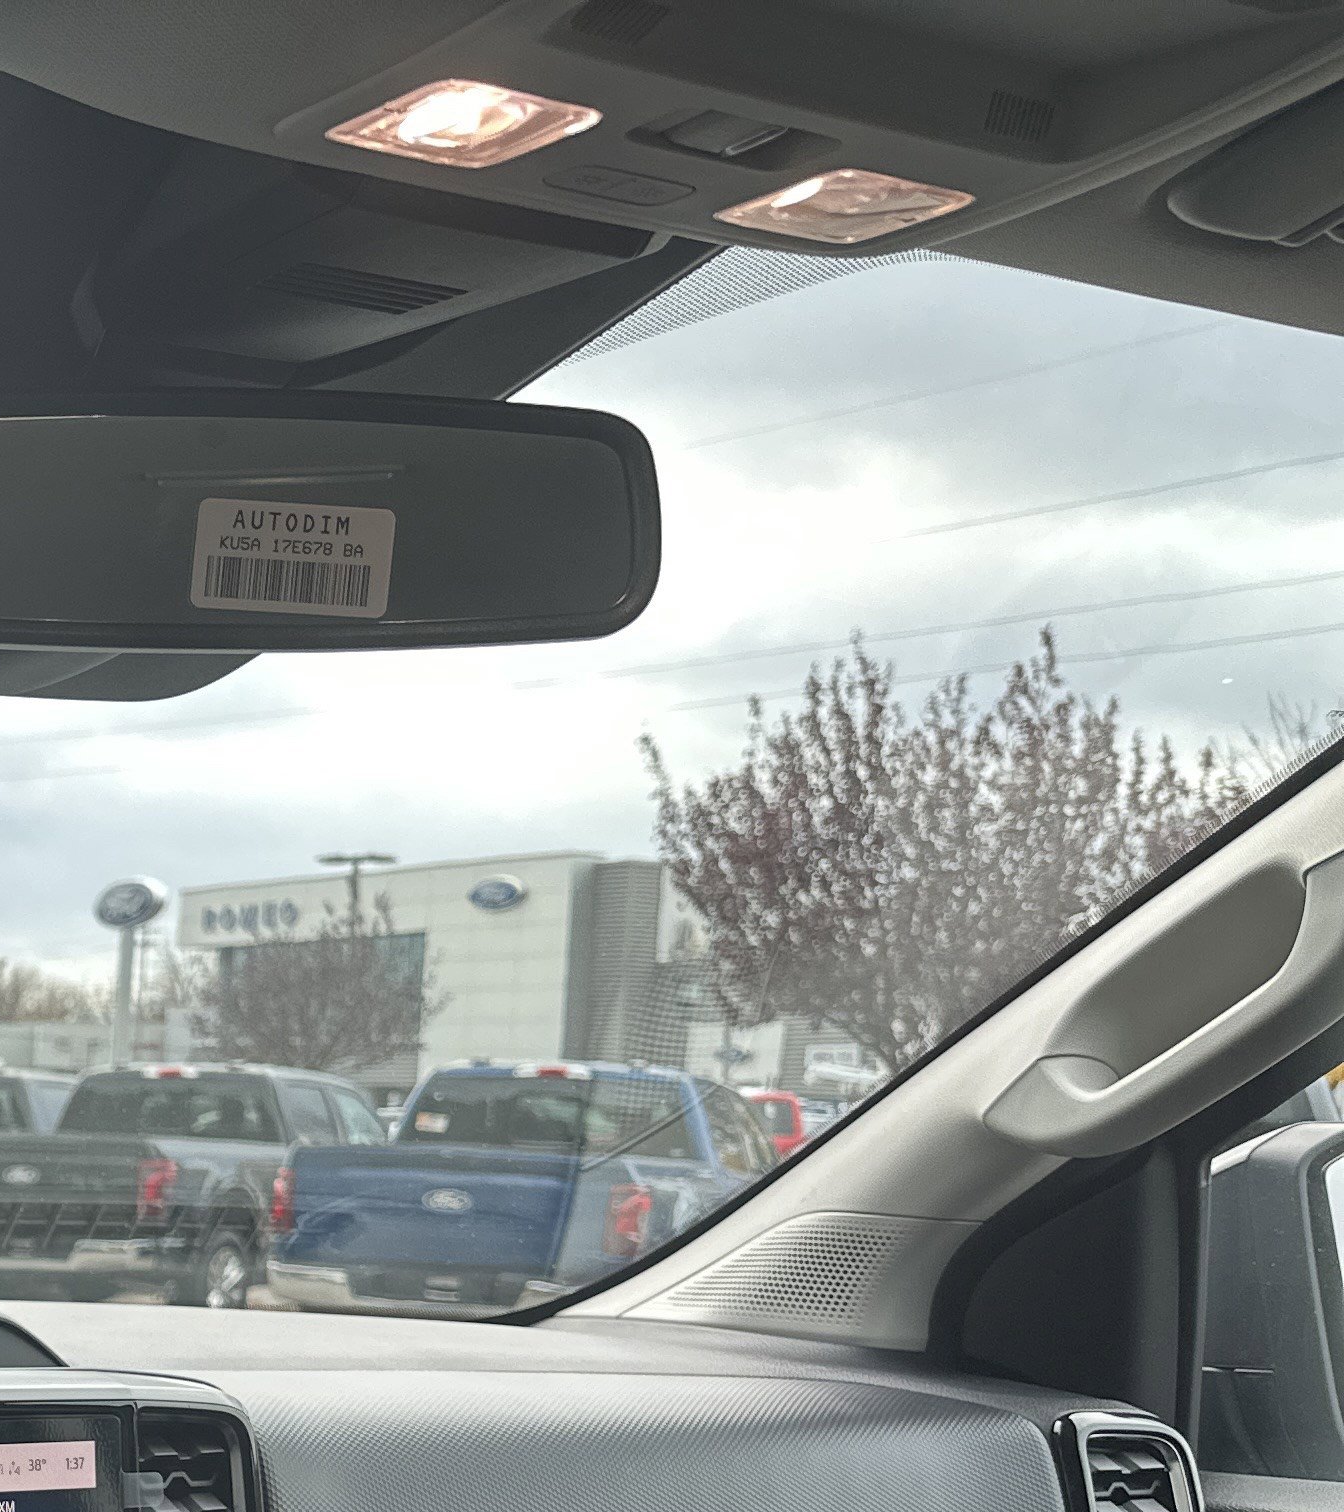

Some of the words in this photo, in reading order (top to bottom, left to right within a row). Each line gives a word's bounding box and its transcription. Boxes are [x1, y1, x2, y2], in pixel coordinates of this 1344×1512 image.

[232, 509, 351, 536] AUTODIM
[273, 539, 333, 556] 17E678
[343, 543, 364, 559] BA
[65, 1456, 85, 1470] 1:37
